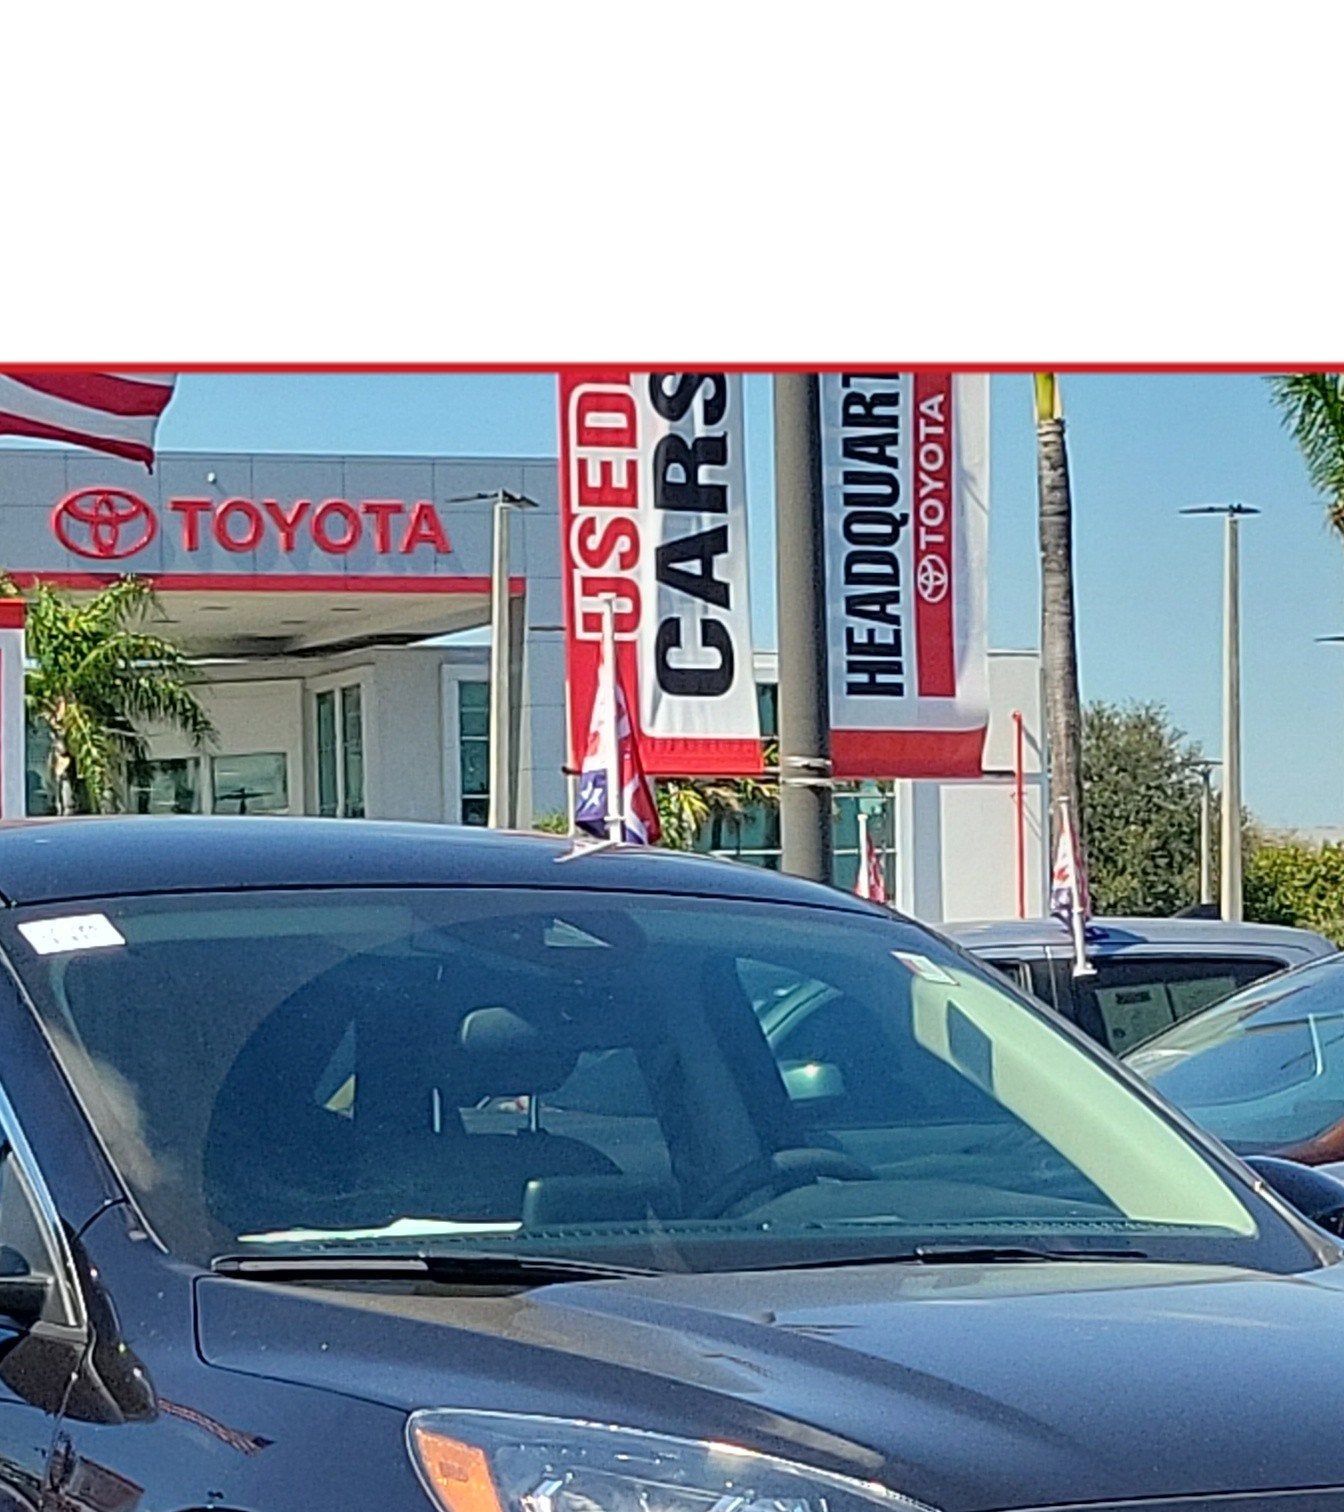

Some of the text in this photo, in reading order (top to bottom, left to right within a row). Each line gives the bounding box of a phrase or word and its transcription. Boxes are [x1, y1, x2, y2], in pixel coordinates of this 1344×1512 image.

[168, 497, 453, 555] TOYOTA
[570, 384, 641, 641] USED
[649, 373, 735, 697] CARS
[842, 373, 909, 697] HEADQUART
[918, 394, 946, 550] TOYOTA
